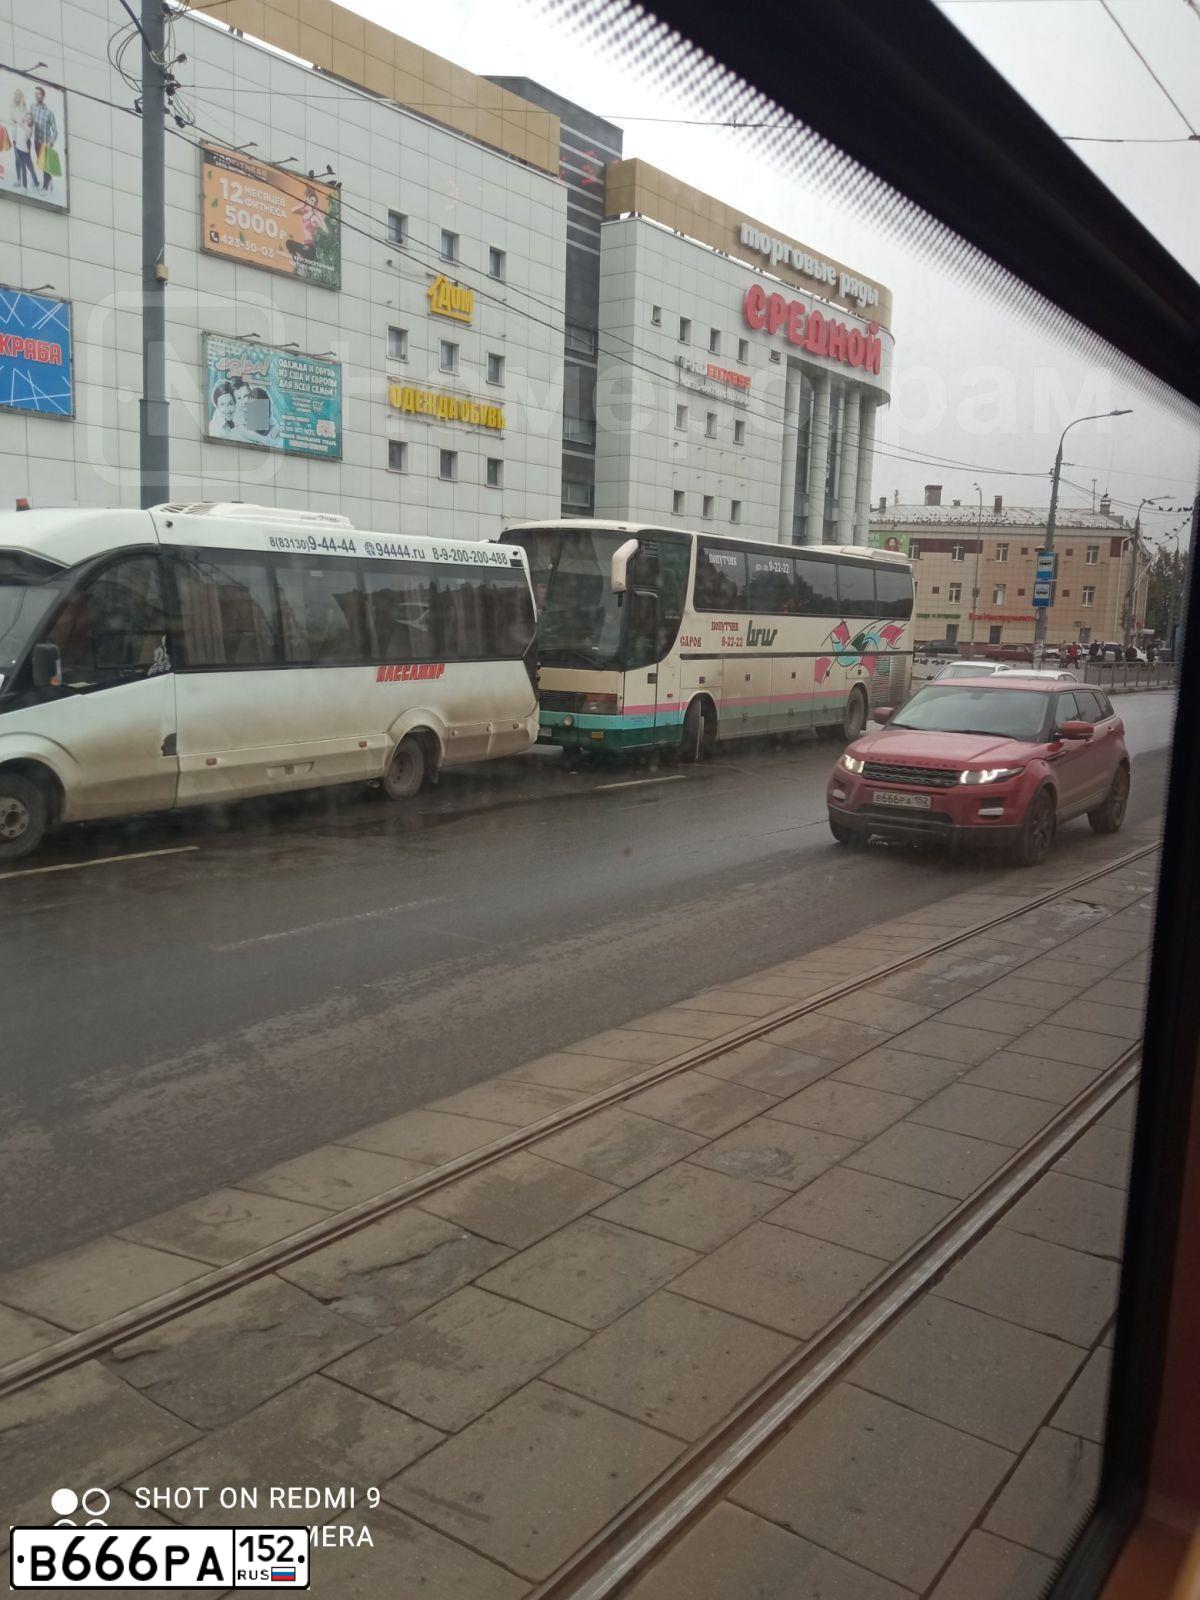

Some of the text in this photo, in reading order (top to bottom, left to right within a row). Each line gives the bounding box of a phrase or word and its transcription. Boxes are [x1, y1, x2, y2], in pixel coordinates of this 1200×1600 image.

[219, 177, 244, 203] 12
[740, 222, 880, 308] торговые ряды
[438, 282, 474, 314] ДОМ
[744, 283, 882, 375] СРЕДНОЙ
[278, 358, 308, 373] ОДЕЖДА
[289, 370, 304, 381] США
[311, 373, 338, 386] ЕВРОПЫ
[389, 384, 506, 431] ОДЕЖДА ОБУВЬ
[376, 542, 426, 560] 94444.ru
[432, 546, 508, 566] 8-9-200-200-488
[709, 553, 738, 567] ПОПУТЧИК
[711, 621, 740, 634] ПОПУТЧИК
[680, 635, 702, 648] САРОВ
[721, 636, 744, 648] 9-22-22
[376, 663, 446, 683] ПАССАЖИР
